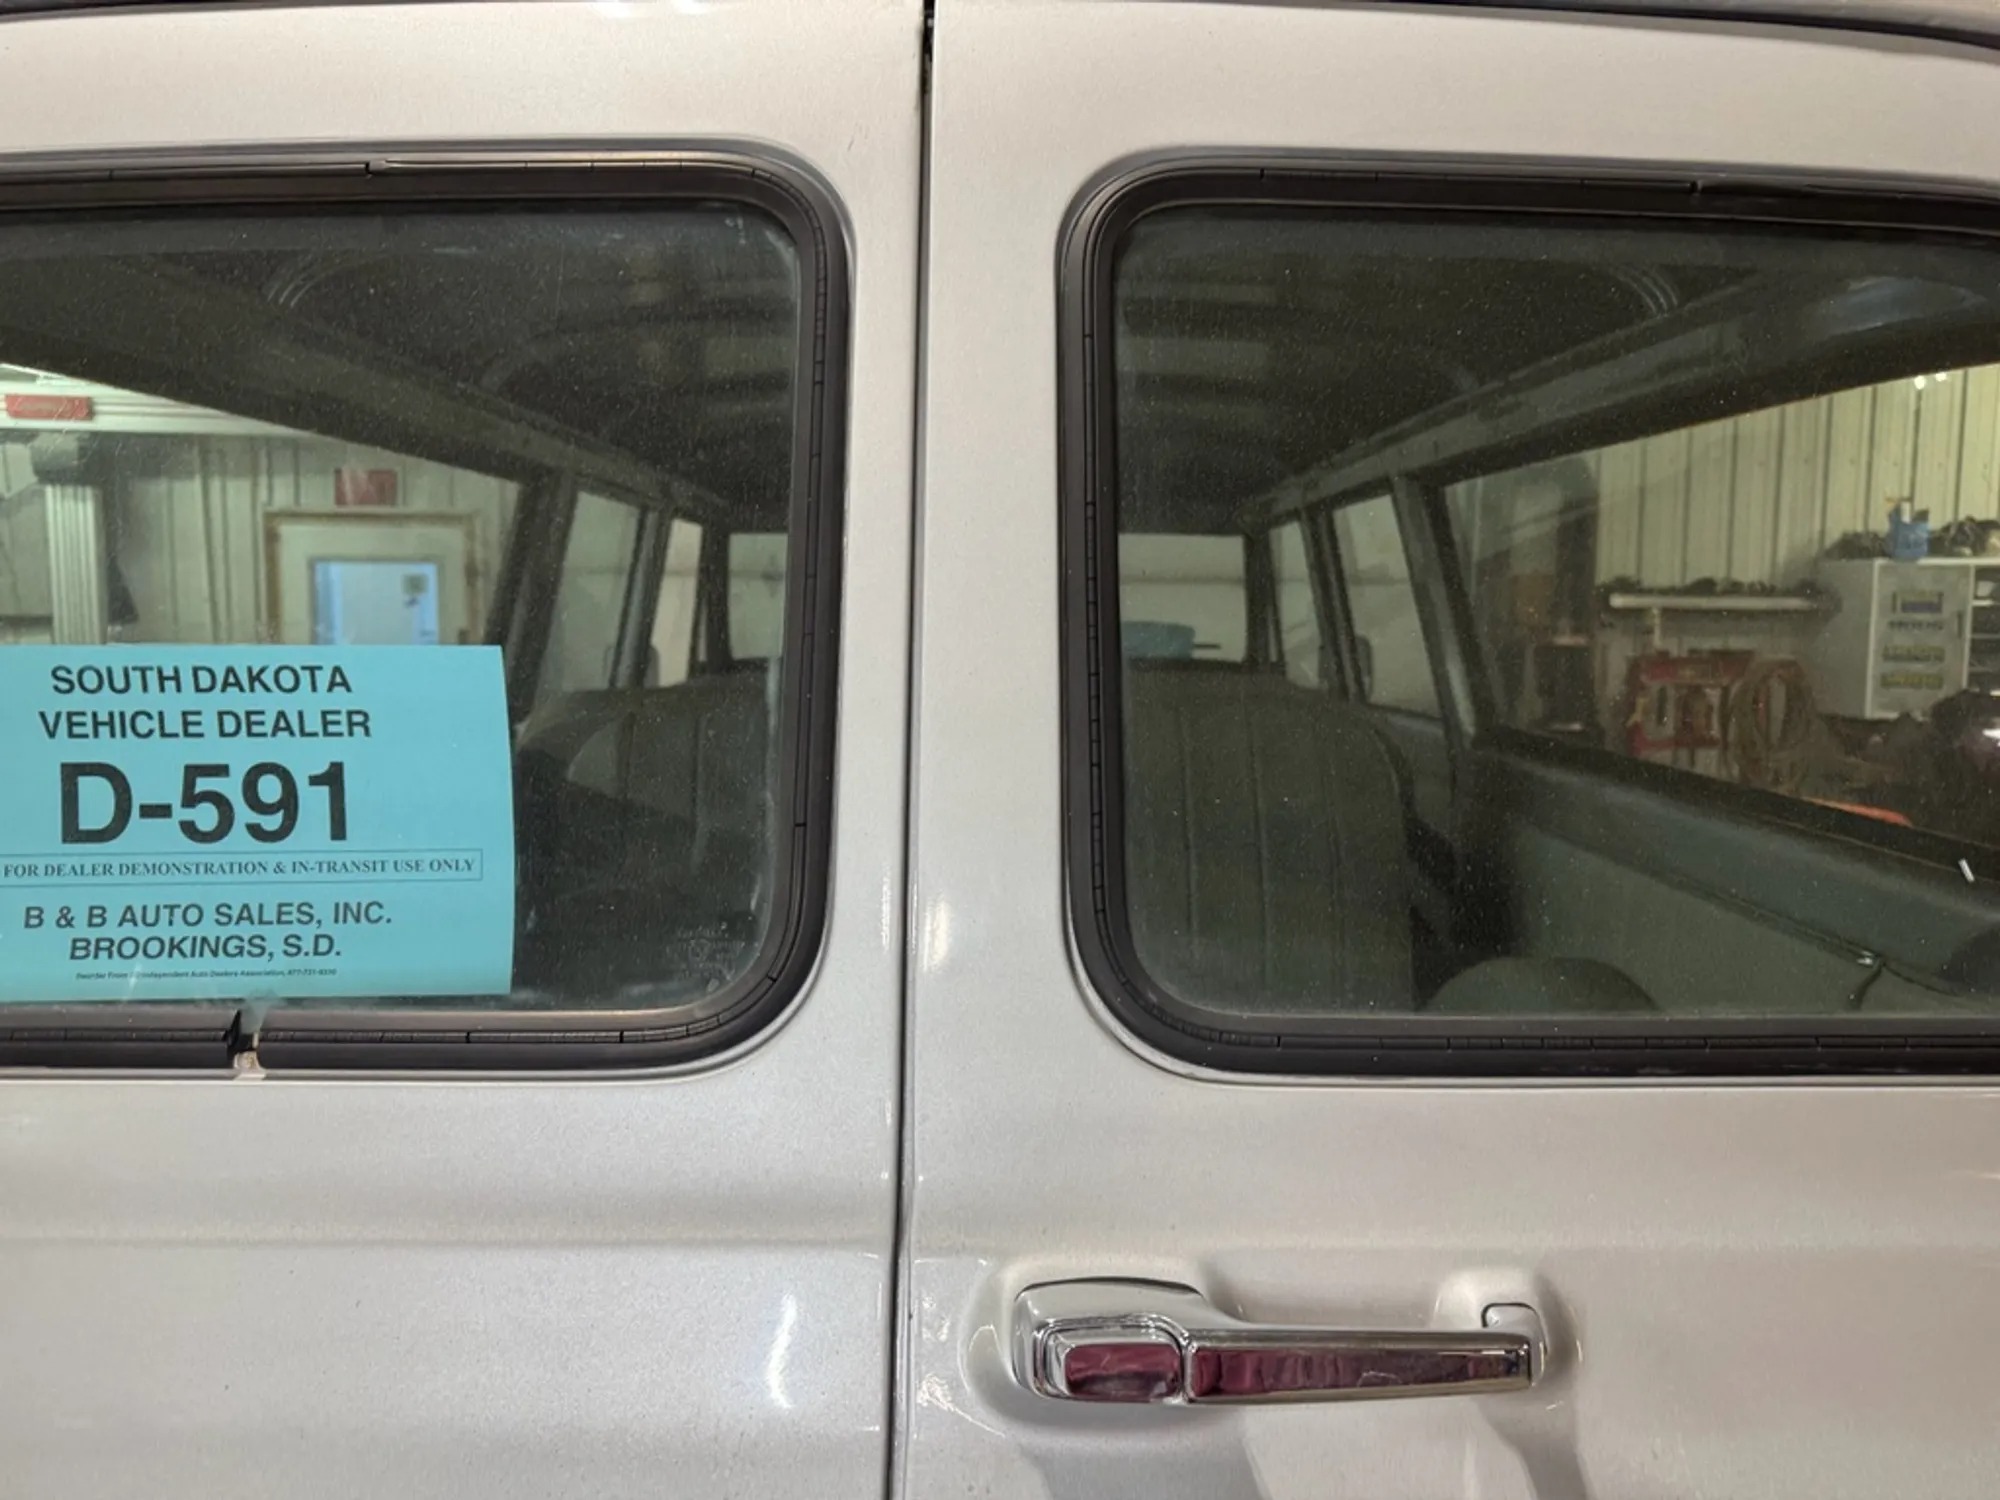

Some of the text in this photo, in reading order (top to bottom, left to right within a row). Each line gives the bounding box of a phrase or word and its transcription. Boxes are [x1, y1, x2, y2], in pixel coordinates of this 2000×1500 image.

[50, 664, 353, 695] SOUTH DAKOTA
[37, 709, 372, 740] VEHICLE DEALER
[59, 761, 348, 844] D-591
[3, 858, 475, 878] FOR DEALER DEMONSTRATION & IN-TRANSIT USE ONLY
[24, 901, 392, 929] B & B AUTO SALES, INC.
[69, 933, 342, 963] BROOKINGS, S.D.
